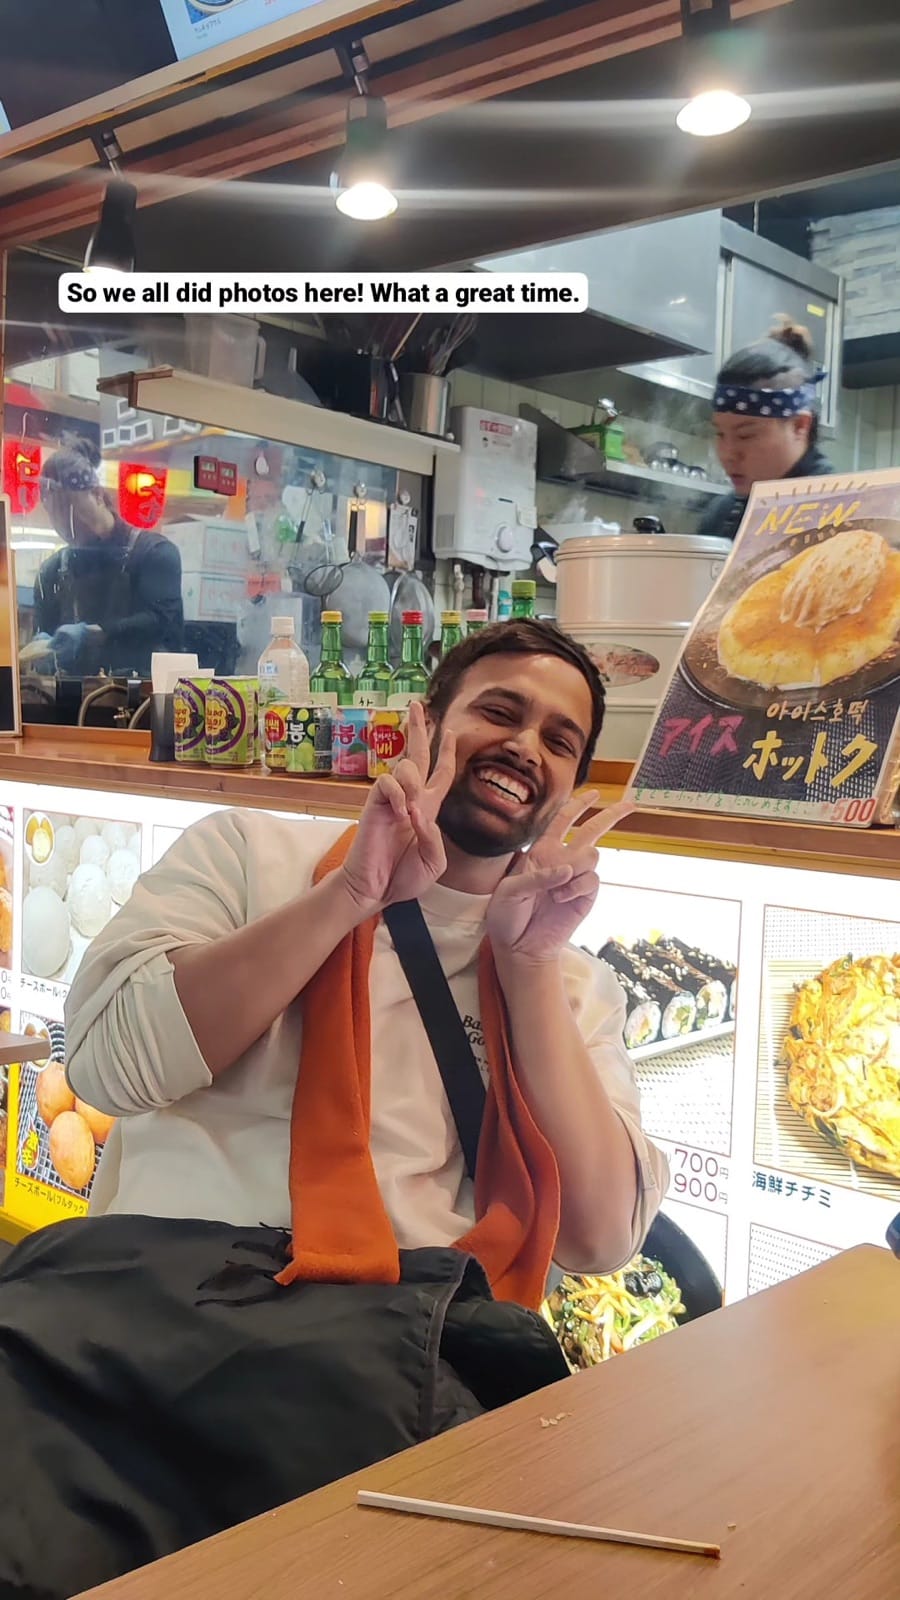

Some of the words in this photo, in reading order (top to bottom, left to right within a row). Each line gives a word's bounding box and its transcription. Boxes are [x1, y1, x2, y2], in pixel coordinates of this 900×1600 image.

[657, 714, 744, 758] アイス
[743, 730, 879, 787] ホットク
